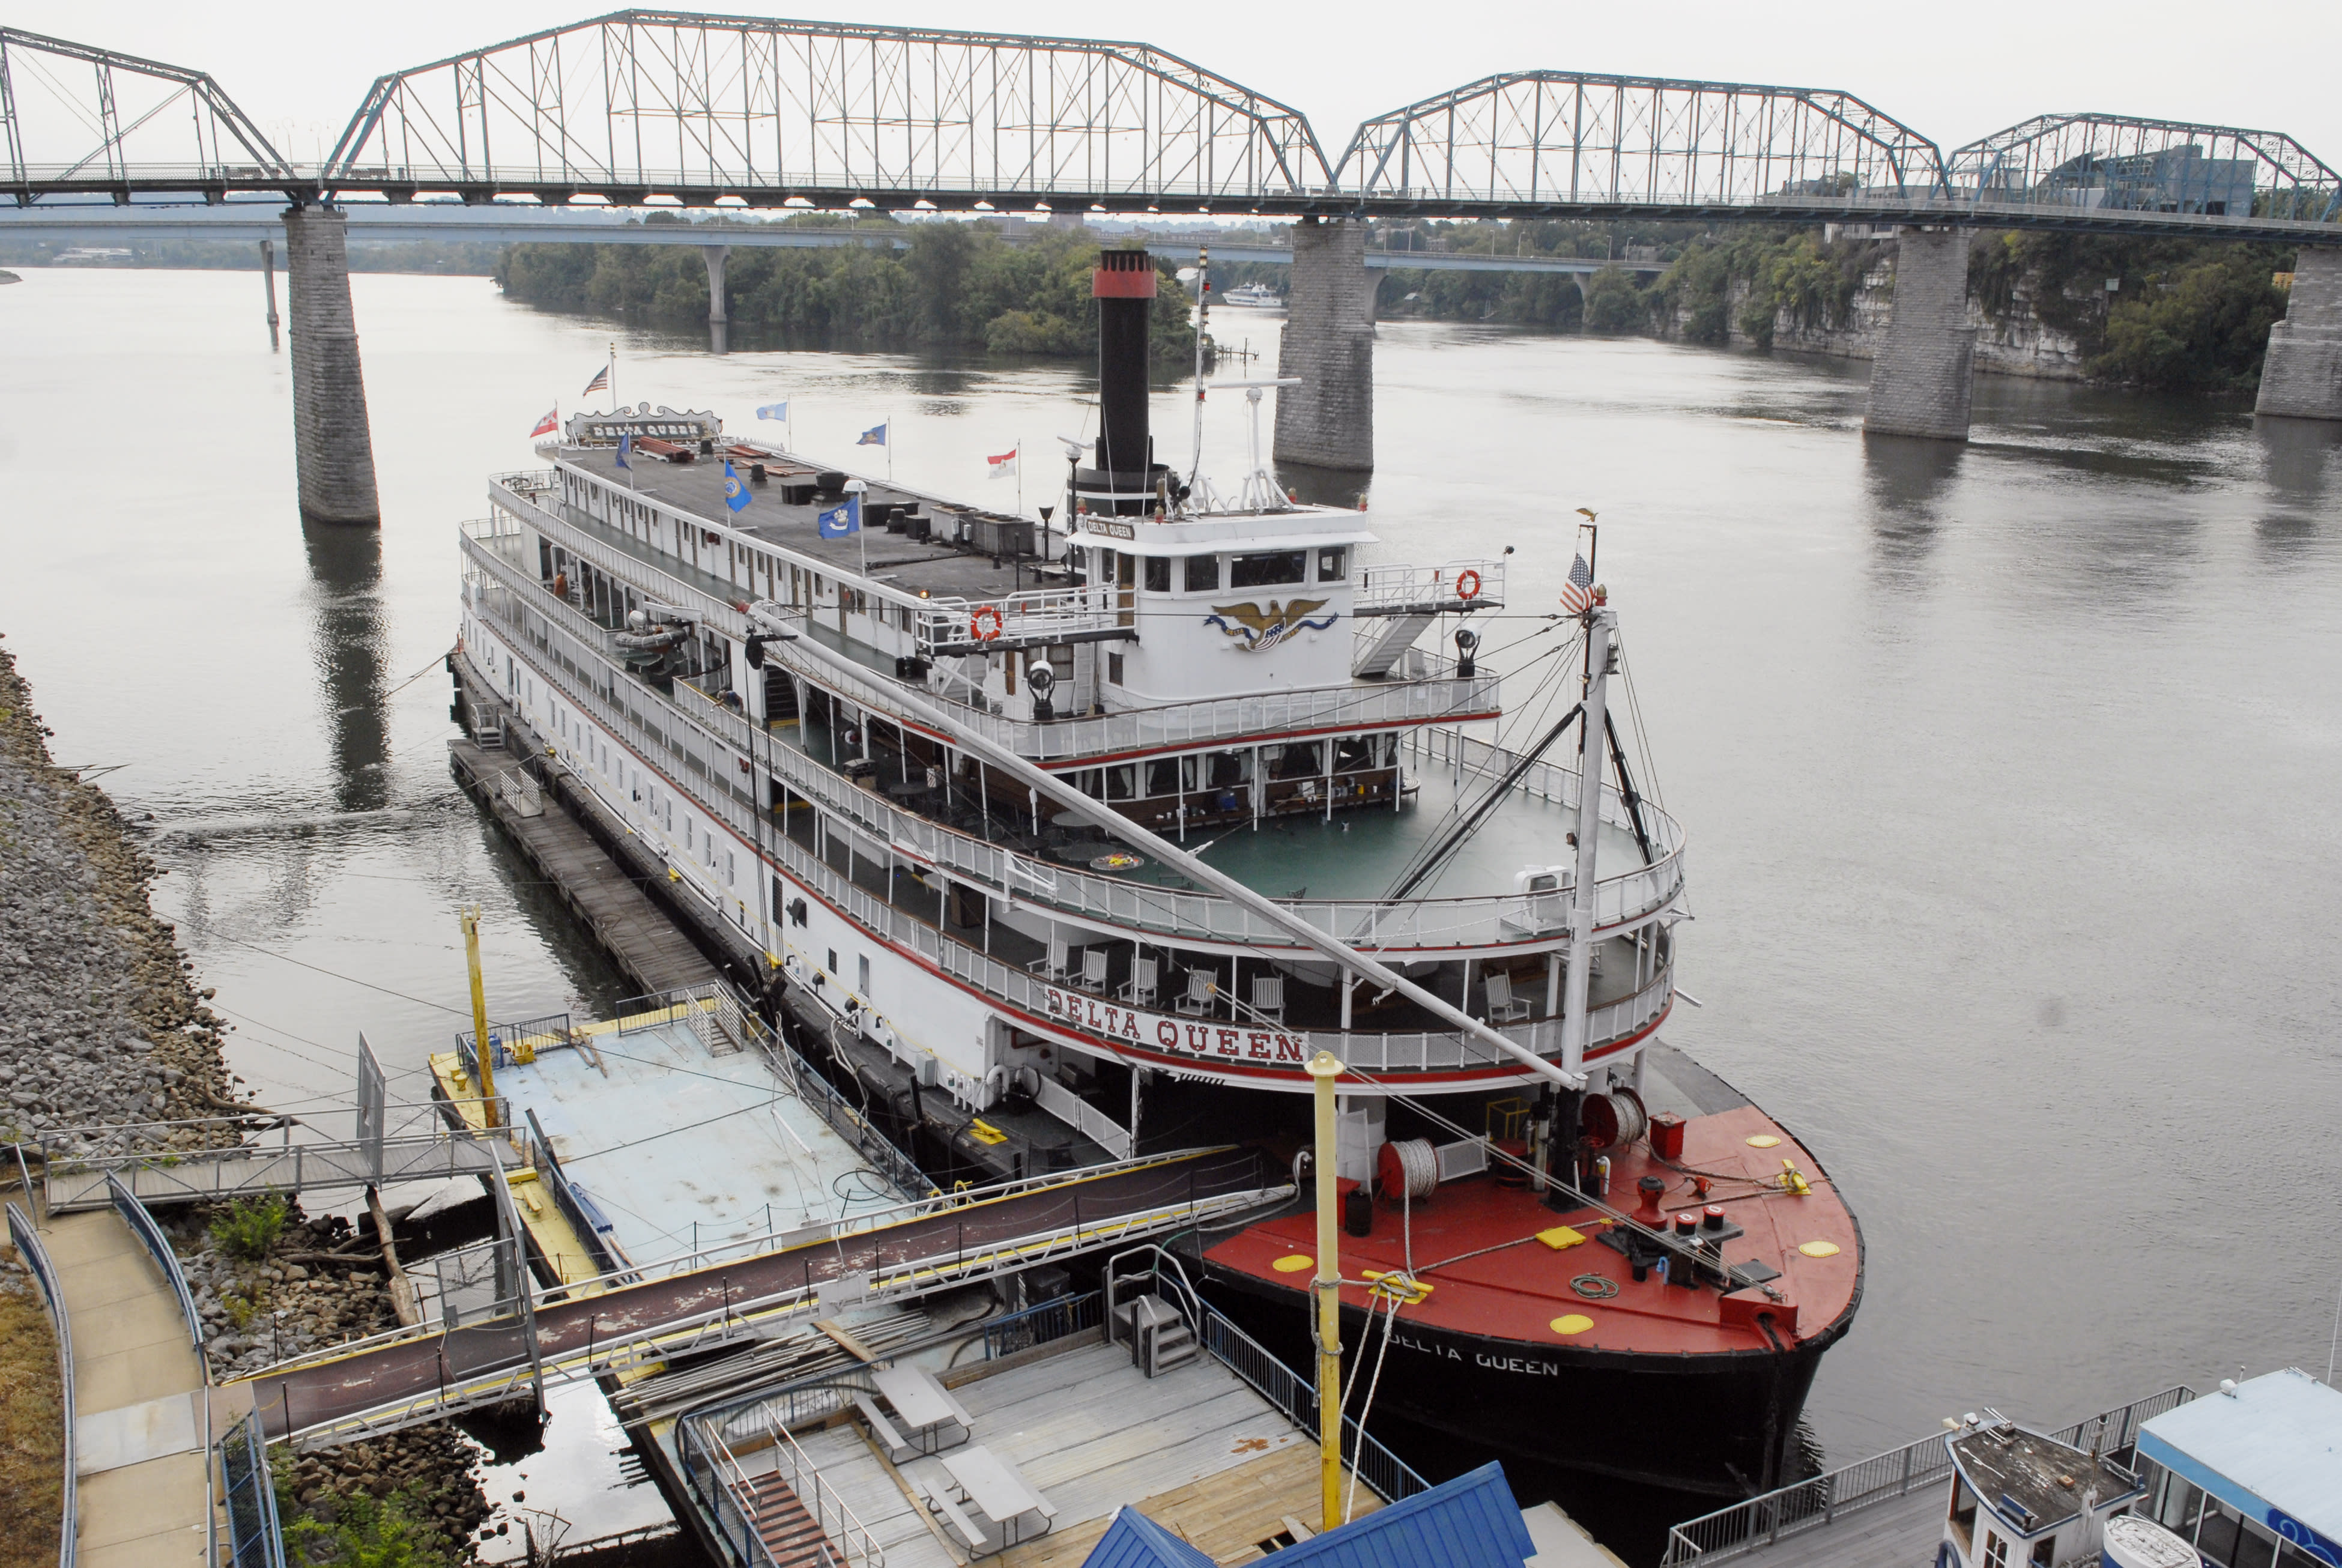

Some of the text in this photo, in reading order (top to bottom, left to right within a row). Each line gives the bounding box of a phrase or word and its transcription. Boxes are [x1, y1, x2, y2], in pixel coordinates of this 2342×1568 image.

[593, 425, 698, 437] DELTA QUEEN
[1088, 521, 1131, 537] DELTA QUEEN
[1047, 988, 1303, 1062] DELTA QUEEN
[1476, 1353, 1558, 1376] QUEEN
